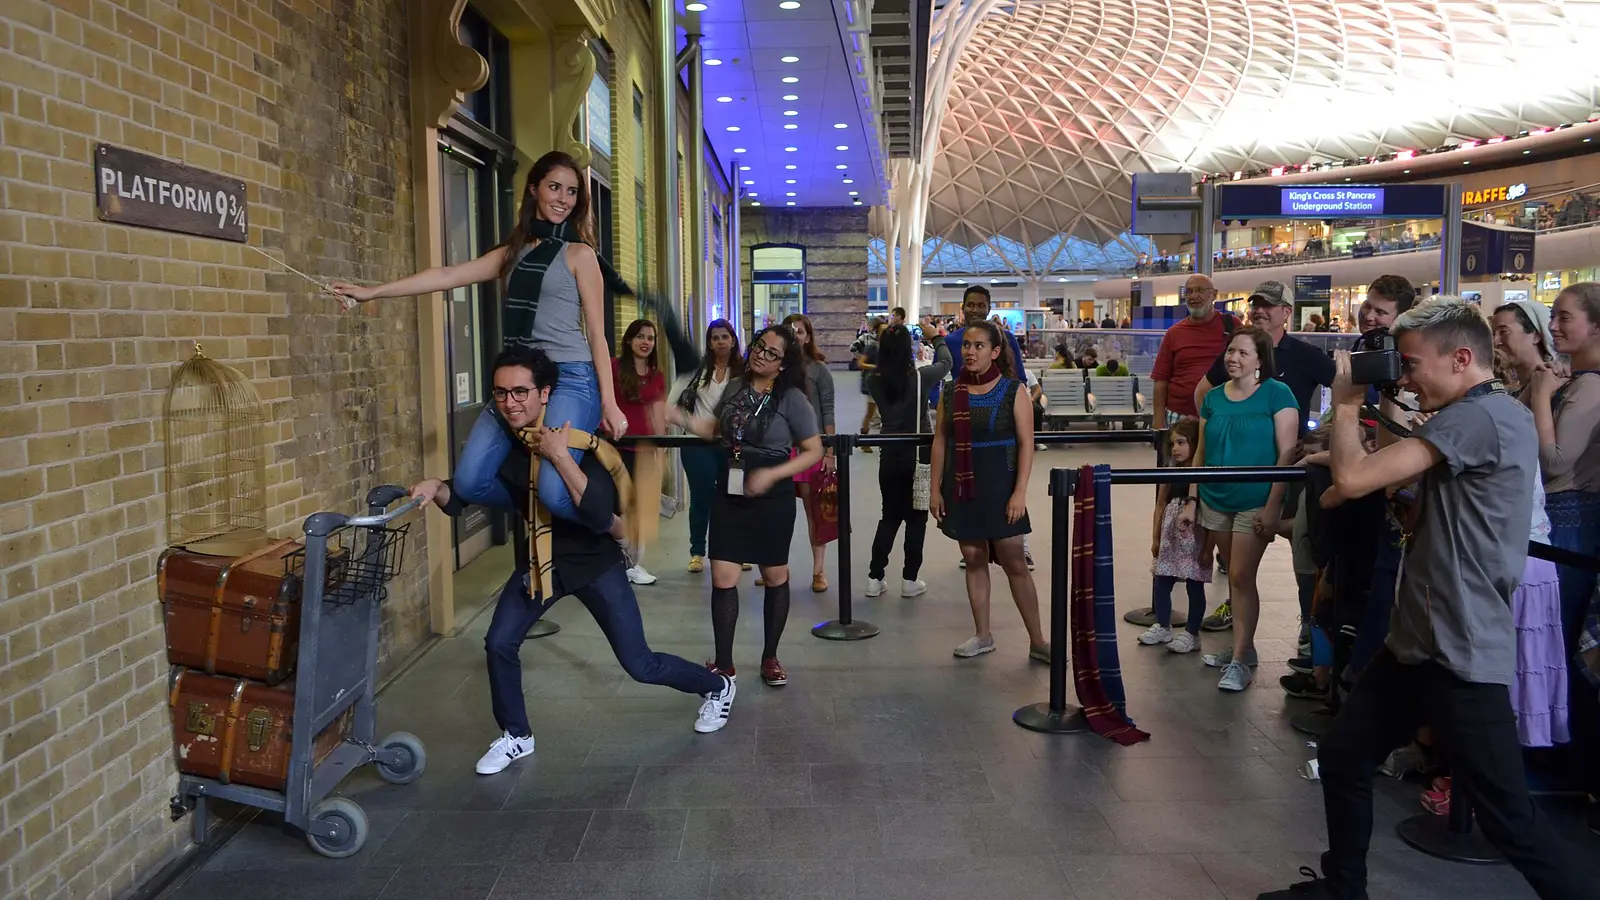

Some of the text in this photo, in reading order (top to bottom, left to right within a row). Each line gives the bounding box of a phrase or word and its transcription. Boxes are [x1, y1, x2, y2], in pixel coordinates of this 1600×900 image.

[101, 167, 212, 214] PLATFORM
[1289, 191, 1376, 201] King's Cross St Pancras
[1461, 186, 1507, 205] IRAFFE
[1292, 201, 1372, 211] Underground Station
